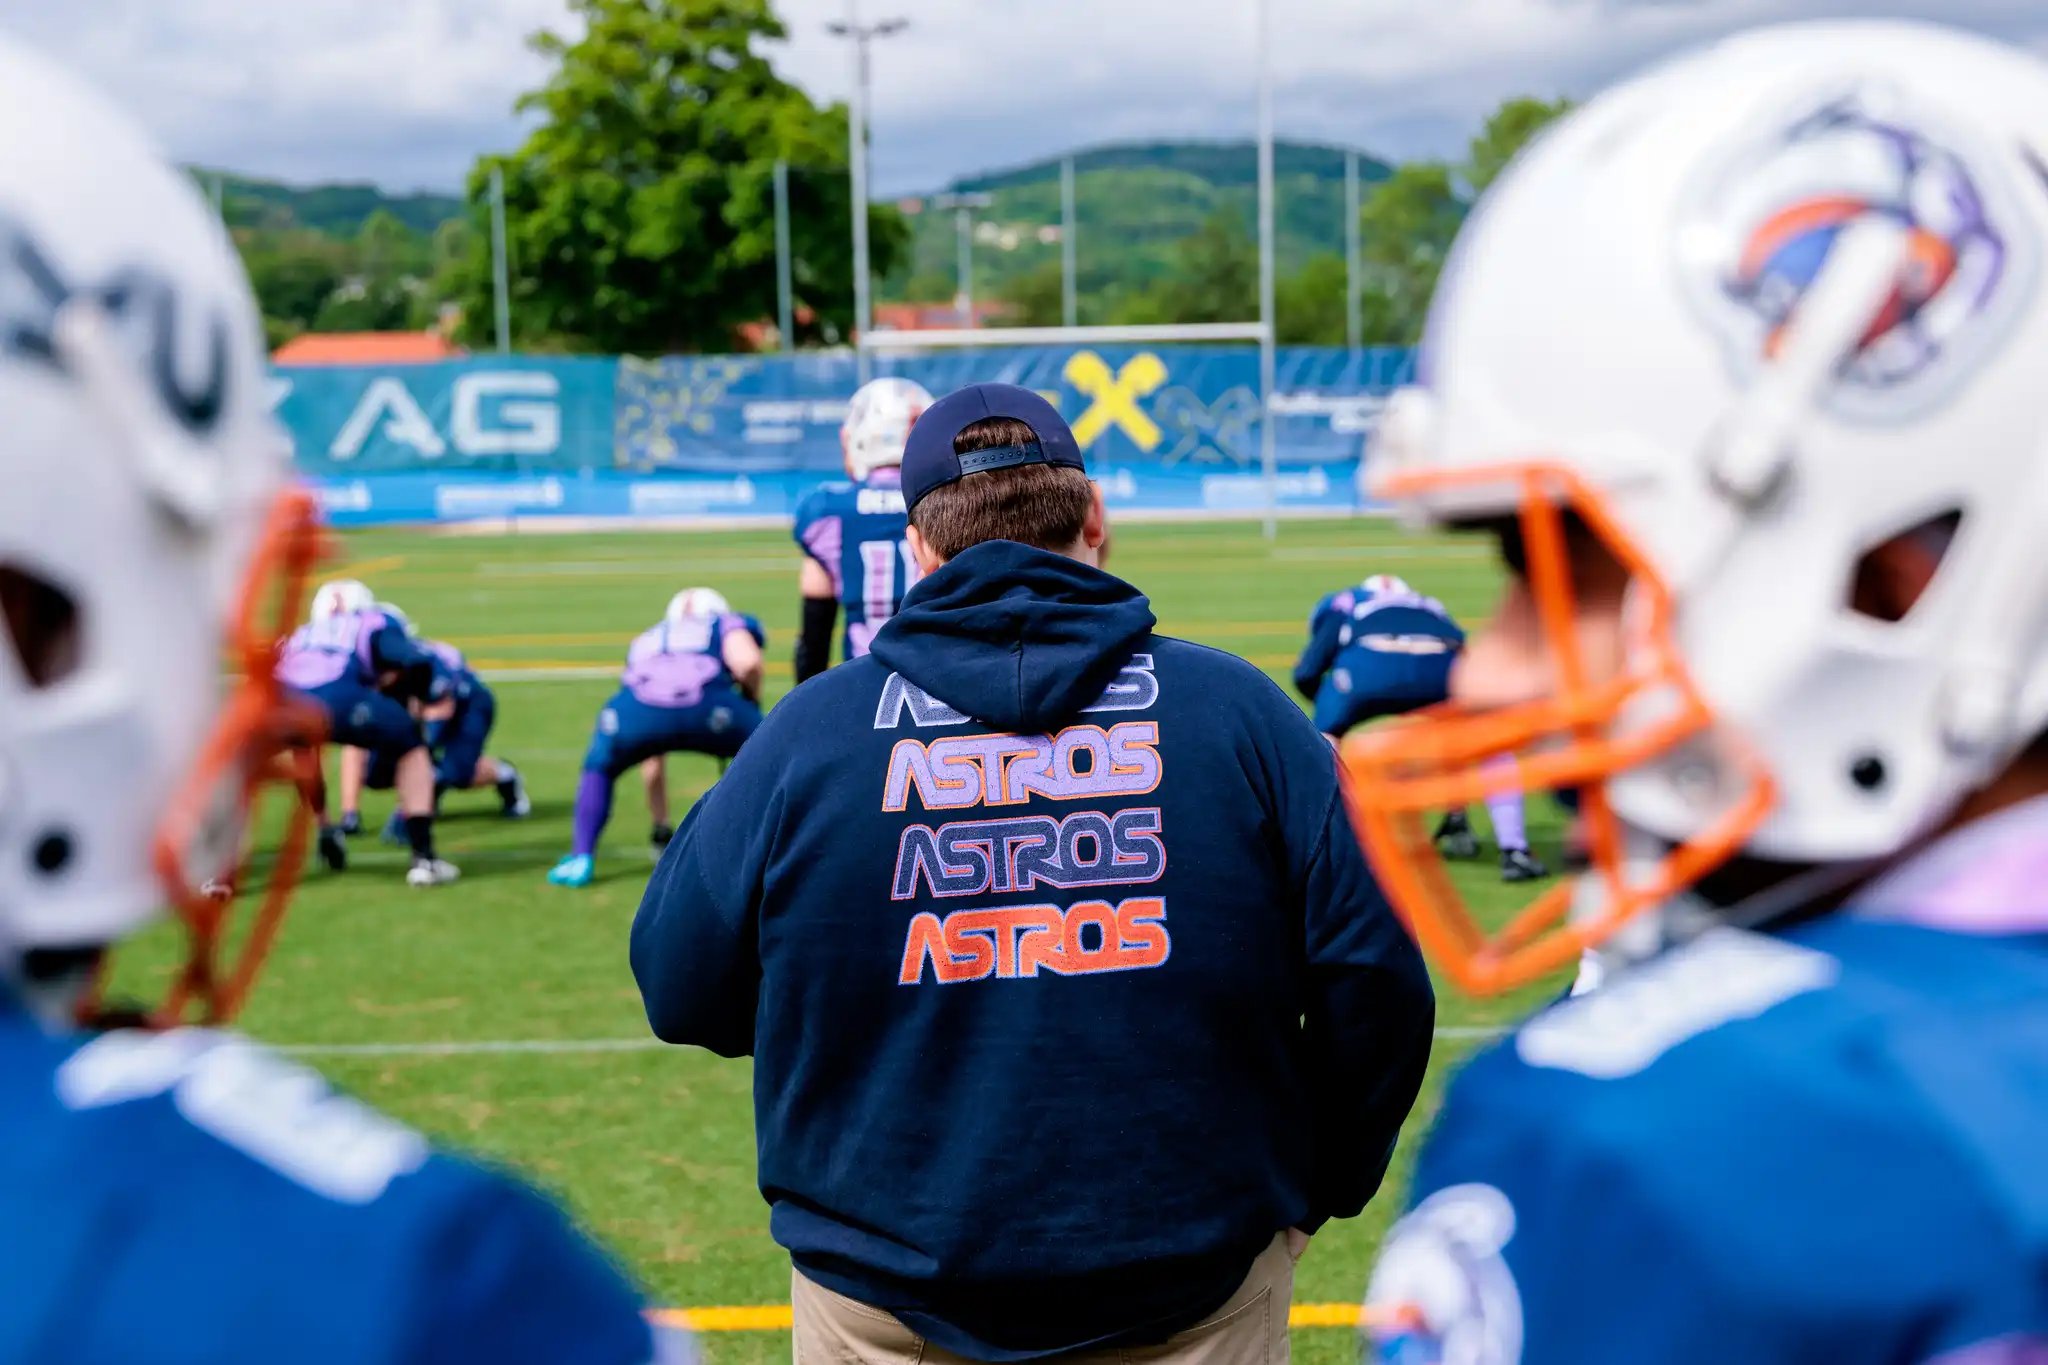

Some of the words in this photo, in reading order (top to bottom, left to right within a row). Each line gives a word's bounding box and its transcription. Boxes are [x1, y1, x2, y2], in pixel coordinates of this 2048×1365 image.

[882, 721, 1163, 812] ASTROS
[891, 807, 1167, 900] ASTROS
[898, 896, 1171, 985] ASTROS
